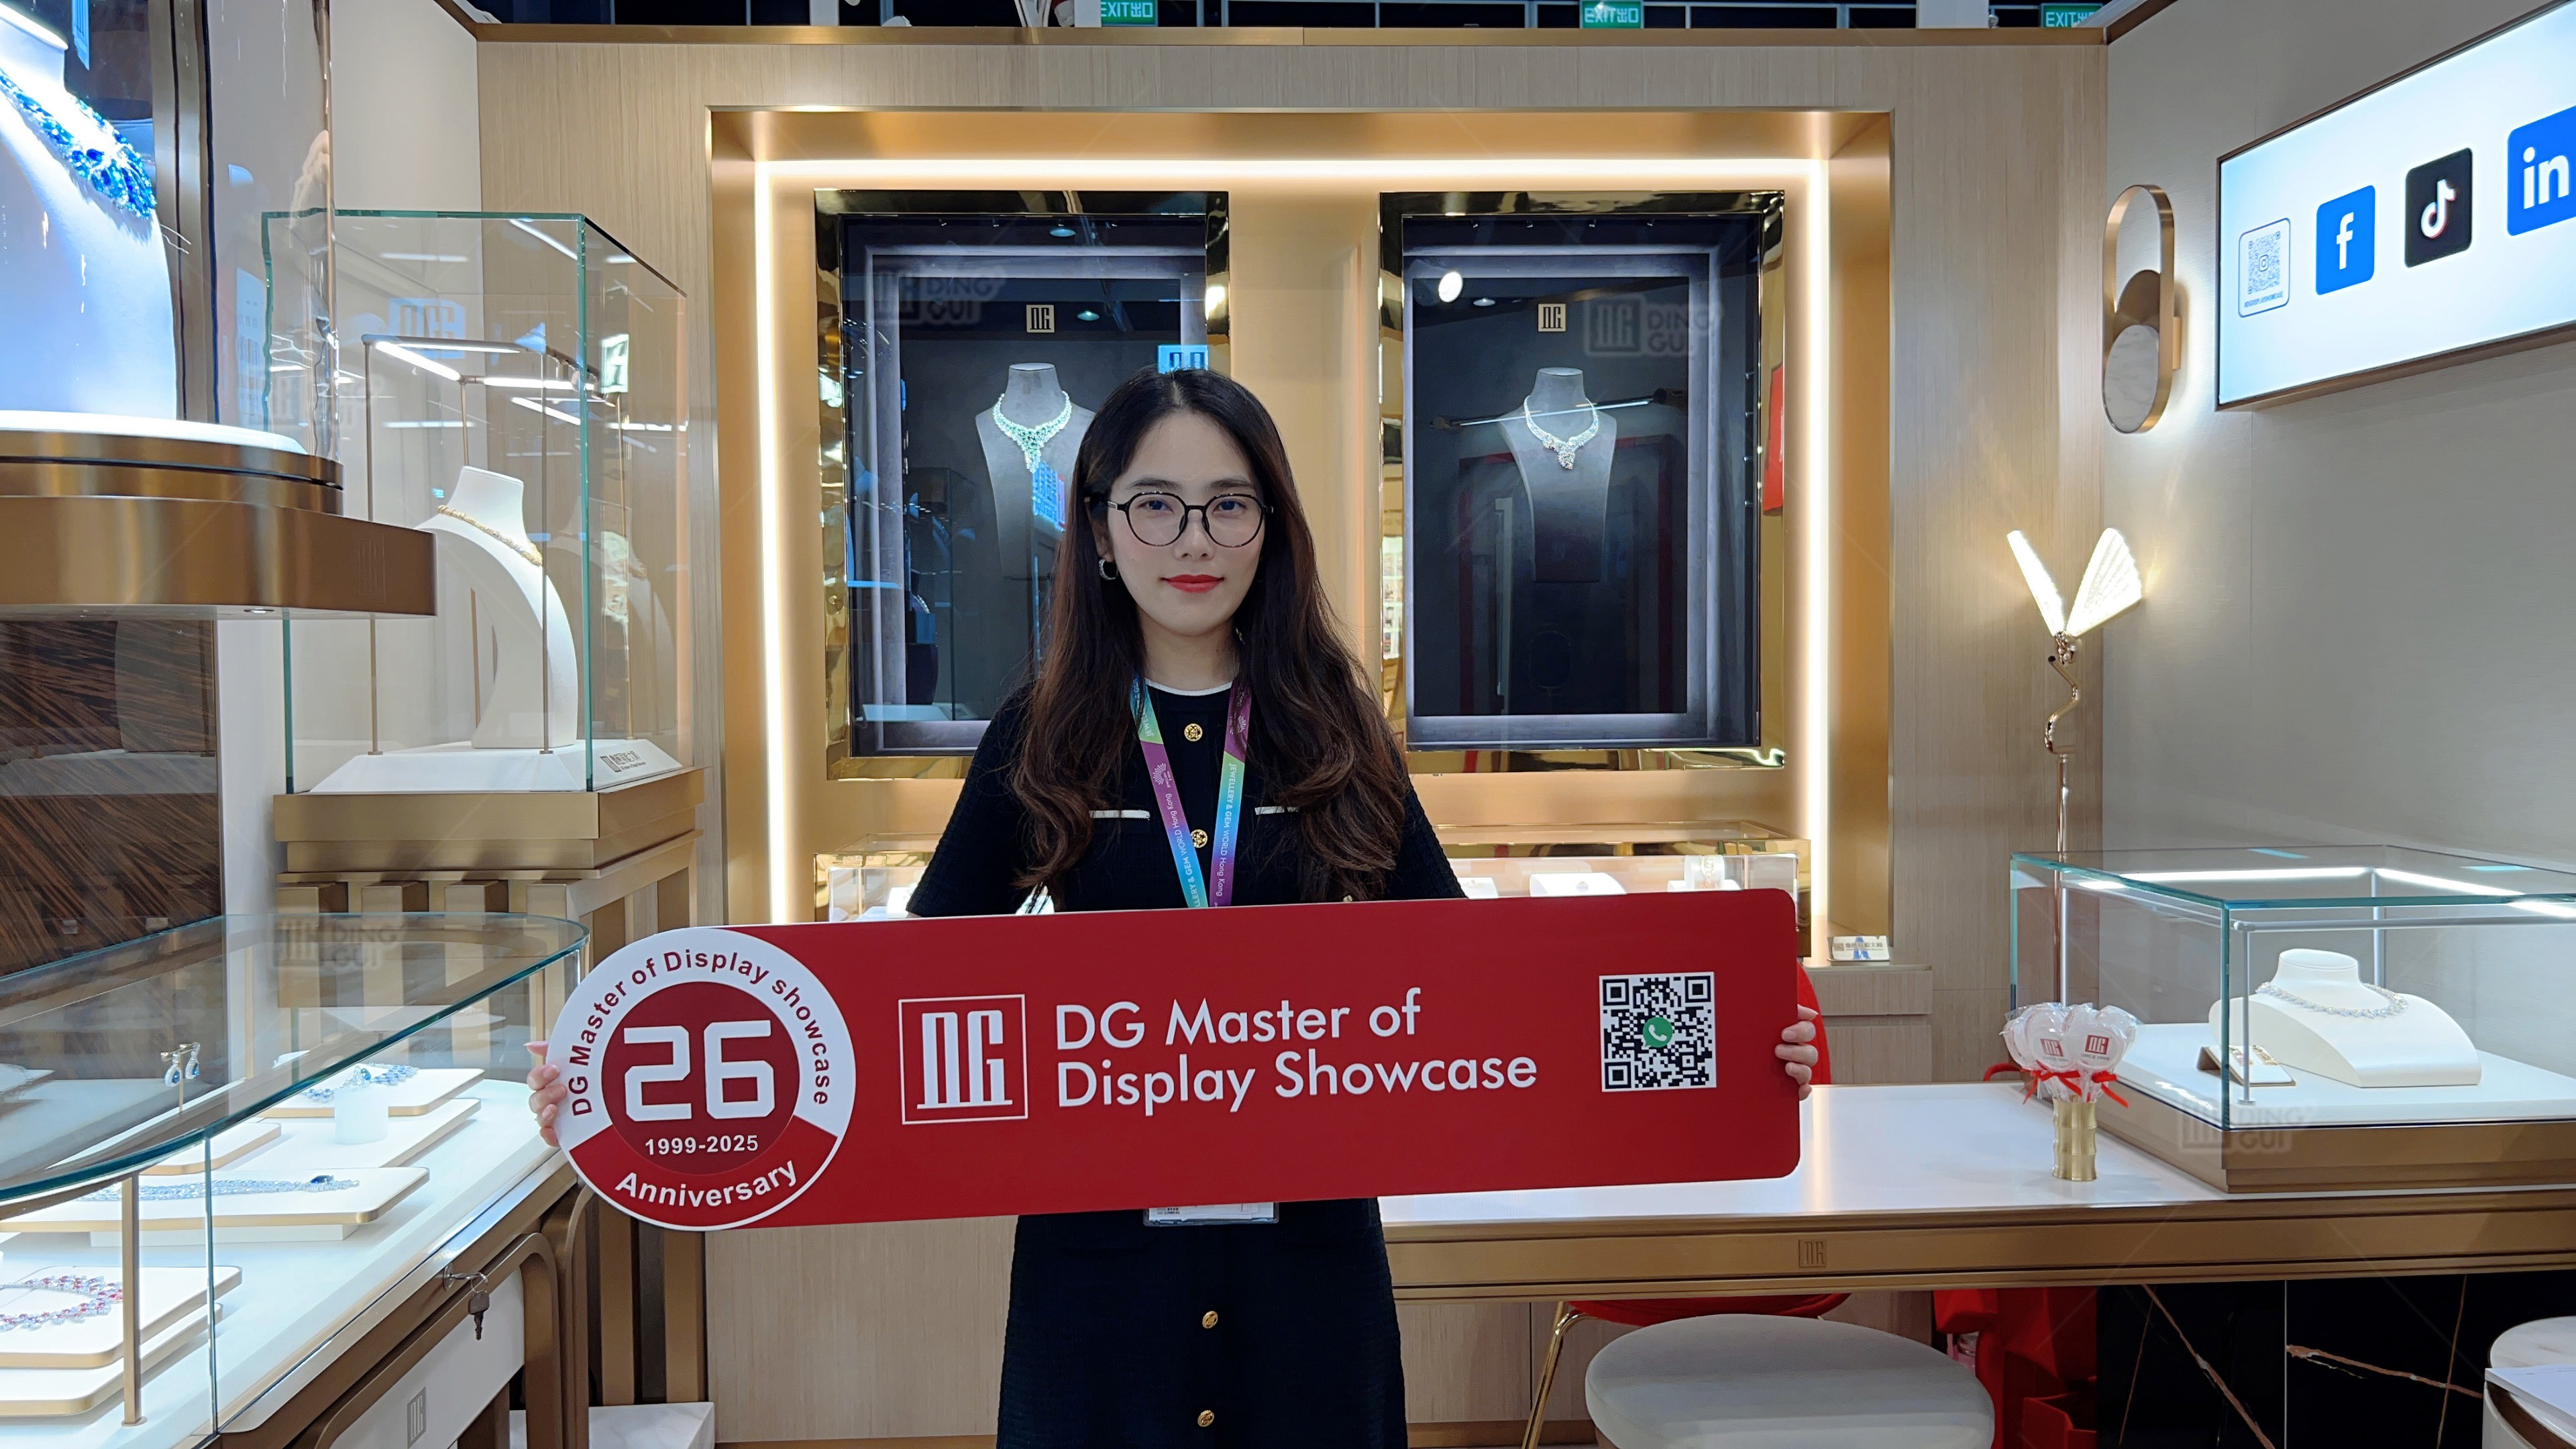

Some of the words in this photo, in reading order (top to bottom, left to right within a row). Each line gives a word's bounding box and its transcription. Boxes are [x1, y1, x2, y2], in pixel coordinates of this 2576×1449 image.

[1101, 2, 1129, 17] EXIT
[1130, 2, 1153, 17] 出口
[1584, 7, 1615, 23] EXIT
[1616, 7, 1639, 23] 出口
[2045, 11, 2077, 28] EXIT
[2523, 146, 2570, 210] in
[2336, 211, 2354, 270] f
[1227, 763, 1237, 802] JEWELLERY
[1165, 793, 1174, 810] Kong
[1170, 810, 1180, 828] Hong
[1224, 812, 1232, 828] GEM
[1174, 830, 1187, 855] WORLD
[1220, 829, 1230, 855] WORLD
[1182, 856, 1193, 876] GEM
[1217, 857, 1226, 876] Hong
[1216, 878, 1225, 897] Kong
[631, 957, 657, 985] of
[663, 949, 770, 985] Display
[569, 981, 628, 1067] Master
[1057, 1002, 1144, 1050] DG
[1166, 998, 1350, 1045] Master
[1368, 987, 1421, 1037] of
[771, 979, 830, 1106] showcase
[623, 1020, 775, 1122] 26
[1058, 1054, 1256, 1116] Display
[1275, 1048, 1537, 1098] Showcase
[568, 1075, 593, 1117] DG
[645, 1134, 759, 1155] 1999-2025
[614, 1160, 797, 1208] Anniversary
